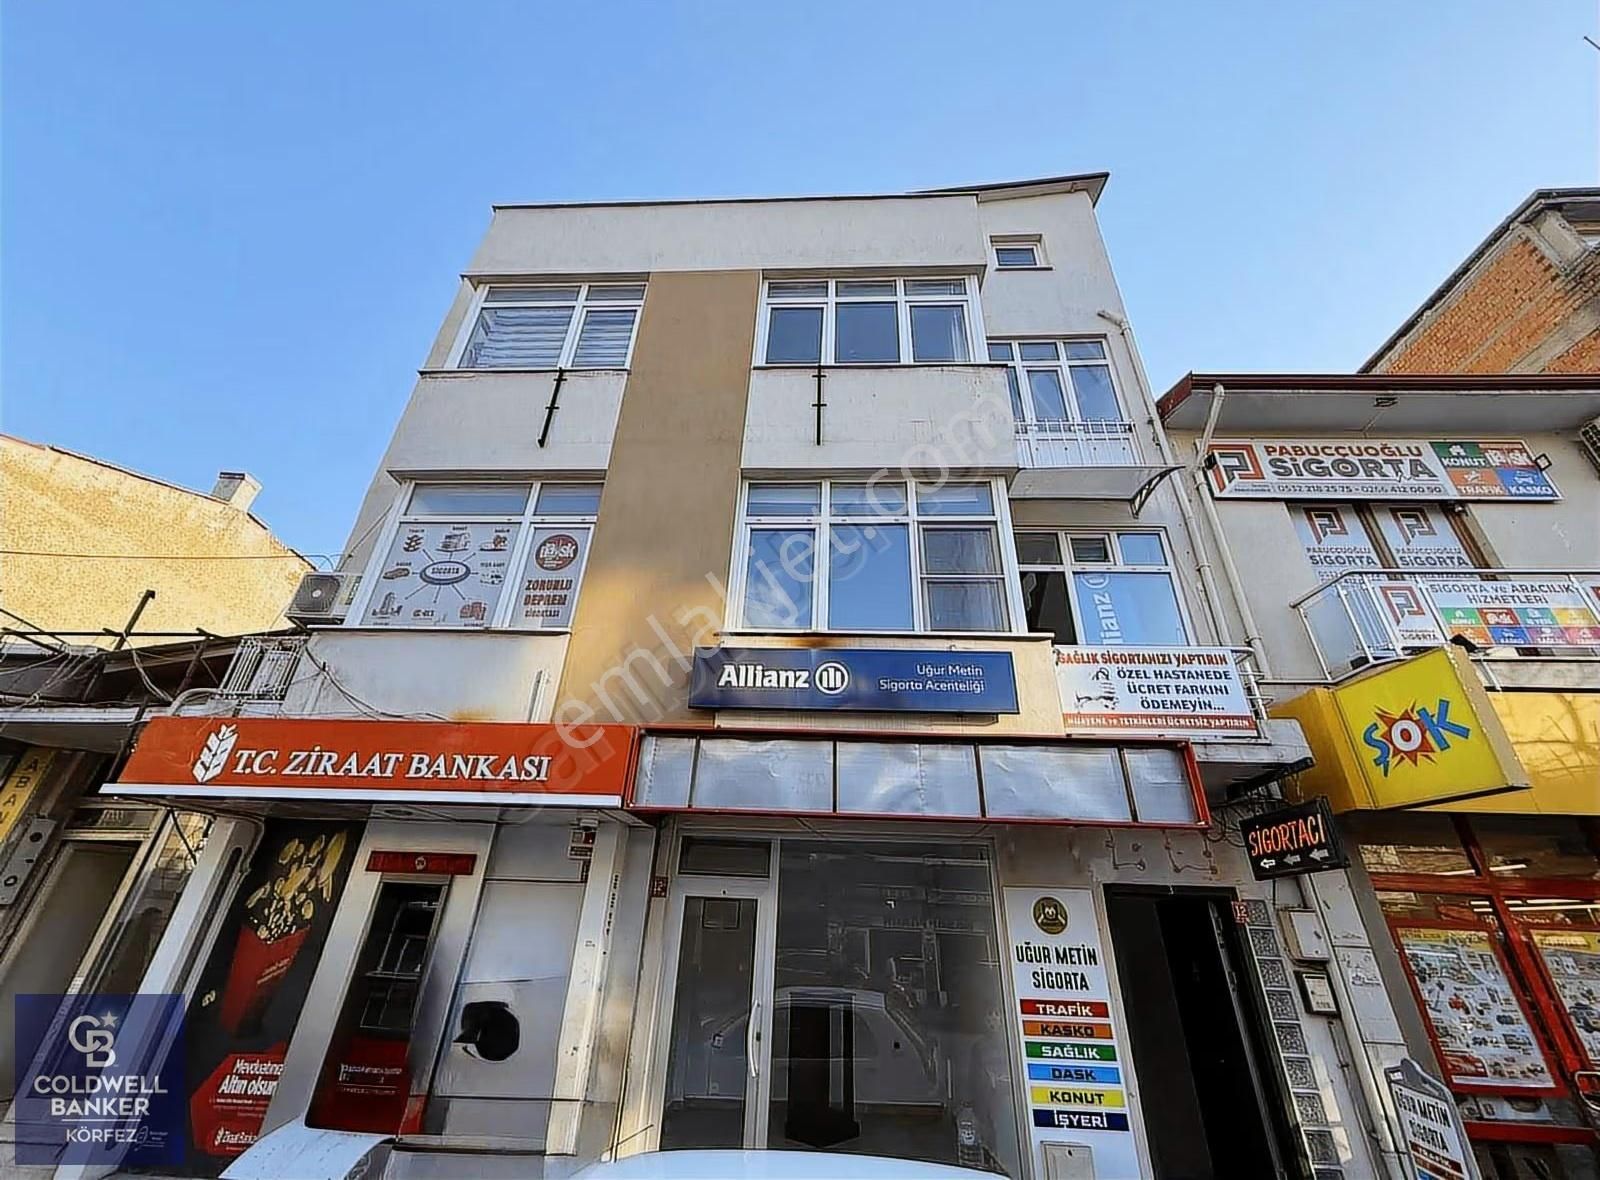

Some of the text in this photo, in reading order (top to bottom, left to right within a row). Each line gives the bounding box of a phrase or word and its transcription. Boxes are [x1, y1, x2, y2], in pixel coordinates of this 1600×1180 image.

[1058, 650, 1228, 667] SAĞLIK SİGORTANIZI YAPTIRIN
[718, 663, 810, 689] Allianz
[917, 664, 983, 678] Uğur Metin
[1116, 667, 1232, 680] ÖZEL HASTANEDE
[879, 679, 985, 693] Sigorta Acenteliği
[1128, 682, 1230, 696] ÜCRET FARKINI
[1363, 699, 1471, 777] ŞOK
[233, 745, 553, 782] T.C. ZİRAAT BANKASI
[1248, 813, 1326, 857] SİGORTACI
[1015, 941, 1098, 966] UĞUR METİN
[1032, 967, 1090, 991] SİGORTA
[1036, 1001, 1094, 1017] TRAFİK
[1040, 1023, 1096, 1037] KASKO
[1041, 1044, 1101, 1059] SAĞLIK
[1051, 1067, 1097, 1081] DASK
[1049, 1090, 1105, 1105] KONUT
[1053, 1110, 1108, 1129] İŞYERİ
